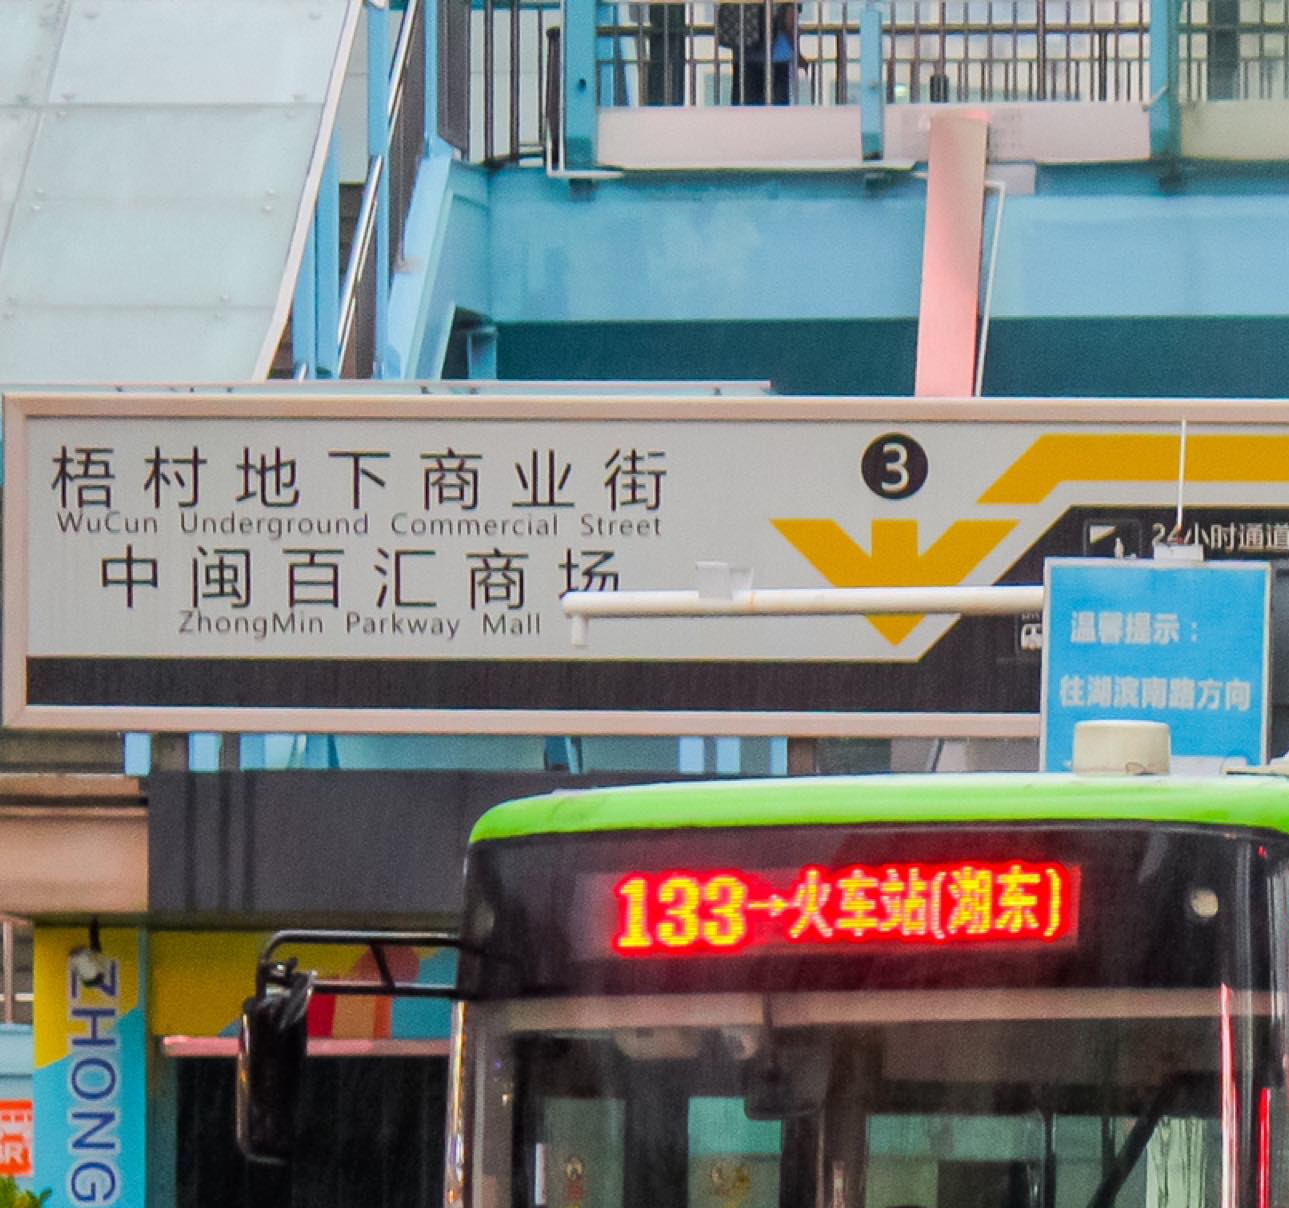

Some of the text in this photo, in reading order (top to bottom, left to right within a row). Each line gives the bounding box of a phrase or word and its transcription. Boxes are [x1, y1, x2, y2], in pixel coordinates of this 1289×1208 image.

[51, 445, 668, 513] 梧村地下商业街
[57, 511, 663, 539] WuCun Underground Commercial Street
[101, 546, 621, 612] 中闽百汇商场
[178, 611, 543, 641] ZhongMin Parkway Mall
[1059, 674, 1252, 712] 往湖滨南路方向
[616, 876, 747, 949] 133
